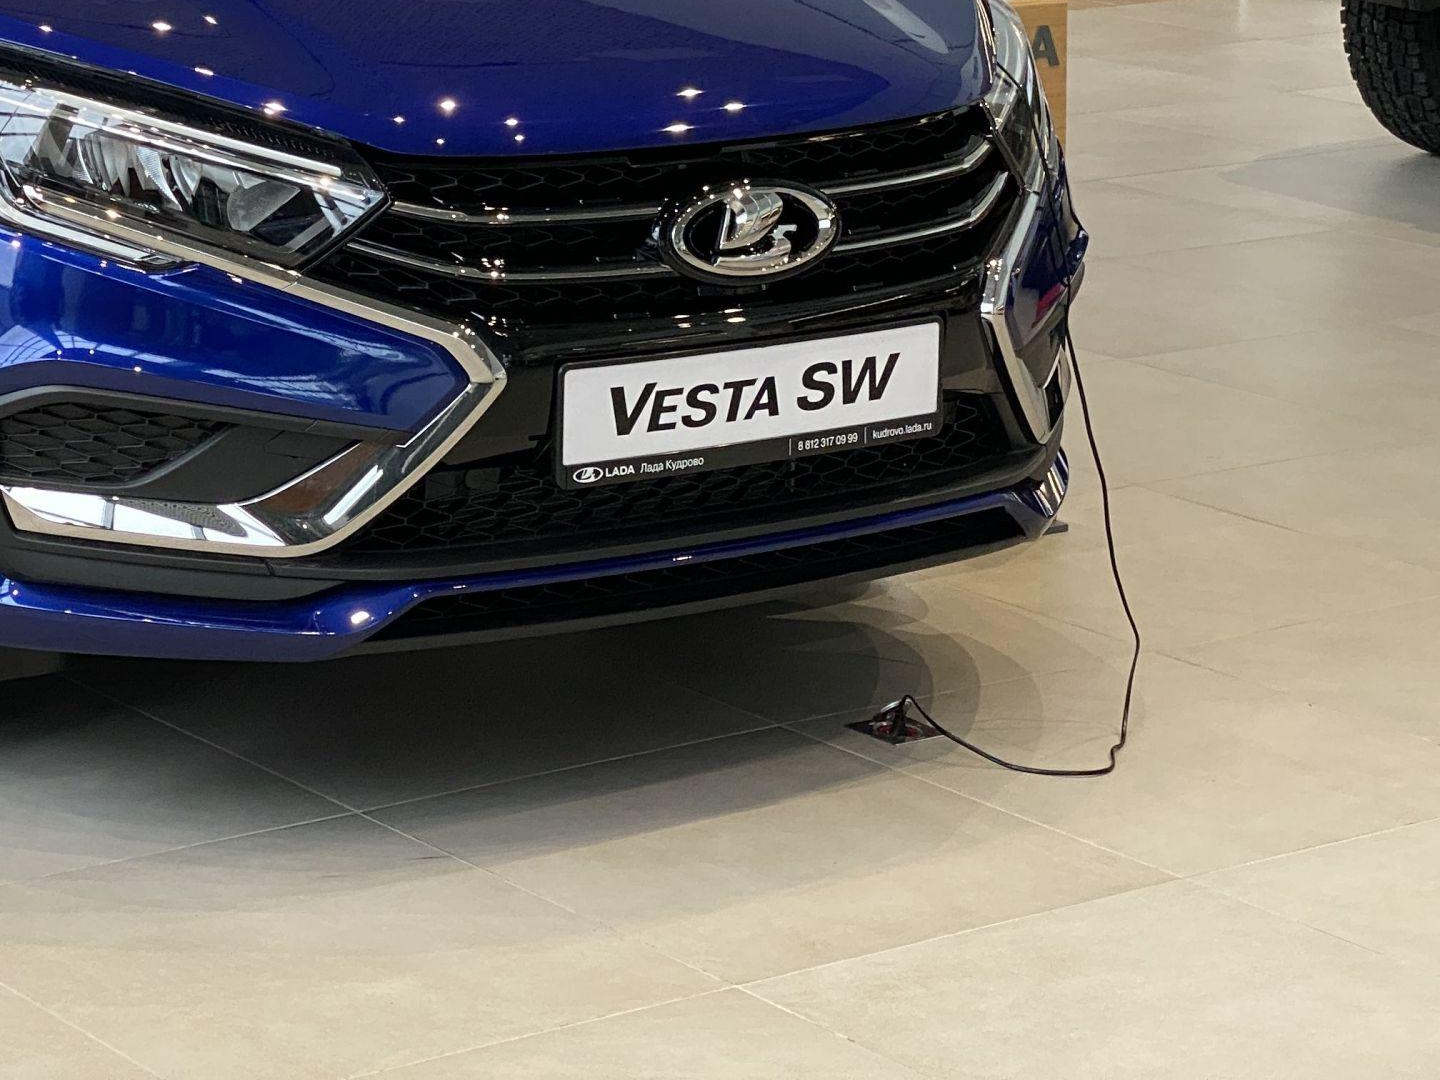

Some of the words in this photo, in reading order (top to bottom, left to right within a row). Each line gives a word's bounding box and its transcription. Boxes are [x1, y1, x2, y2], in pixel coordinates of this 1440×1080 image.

[610, 374, 780, 437] VESTA
[797, 352, 901, 412] SW
[872, 422, 933, 439] kudrovo.lada.ru
[797, 440, 804, 451] 8
[805, 438, 819, 450] 812
[820, 436, 835, 448] 317
[836, 434, 847, 445] 09
[847, 432, 858, 443] 99
[605, 465, 635, 477] LADA
[640, 462, 664, 473] Лада
[666, 457, 705, 471] Кудрово
